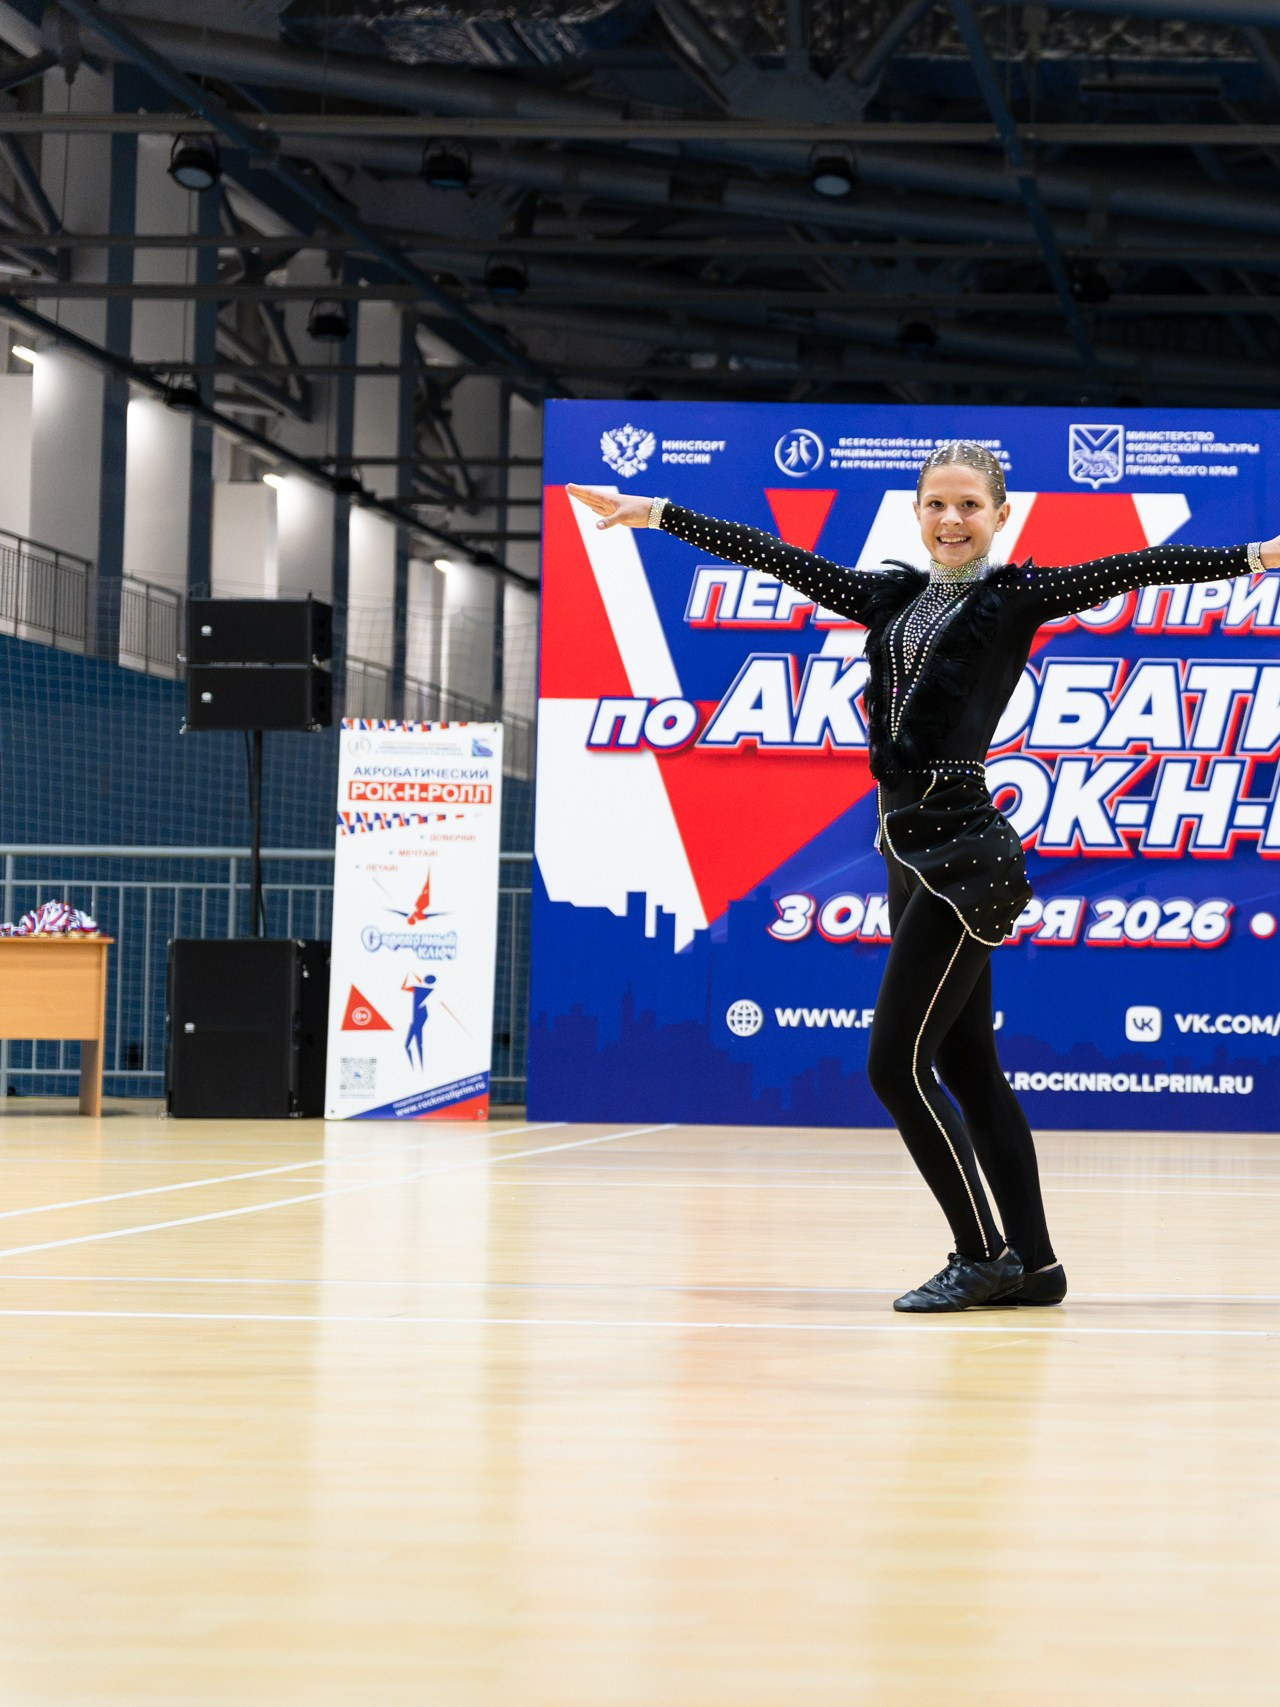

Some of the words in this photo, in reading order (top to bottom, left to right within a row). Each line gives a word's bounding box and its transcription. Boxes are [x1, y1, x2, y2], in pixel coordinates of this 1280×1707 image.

[1126, 430, 1215, 442] МИНИСТЕРСТВО
[662, 440, 726, 452] МИНСПОРТ
[839, 437, 933, 448] ВСЕРОССИЙСКАЯ
[1126, 442, 1200, 453] ФИЗИЧЕСКОЙ
[1202, 443, 1260, 454] КУЛЬТУРЫ
[662, 453, 711, 464] РОССИИ
[830, 448, 911, 459] ТАНЦЕВАЛЬНОГО
[1126, 453, 1135, 464] И
[1136, 454, 1181, 464] СПОРТА
[830, 460, 839, 469] И
[840, 460, 925, 470] АКРОБАТИЧЕСКО
[1126, 464, 1208, 476] ПРИМОРСКОГО
[1208, 466, 1238, 477] КРАЯ
[353, 766, 489, 780] АКРОБАТИЧЕСКИЙ
[351, 782, 490, 803] РОК-Н-РОЛЛ
[767, 893, 816, 942] 3
[817, 893, 1087, 945] ОКРЯ
[1084, 896, 1235, 948] 2026
[1003, 1071, 1253, 1095] .ROCKNROLLPRIM.RU
[395, 1082, 486, 1117] www.rocknrollprim.ru
